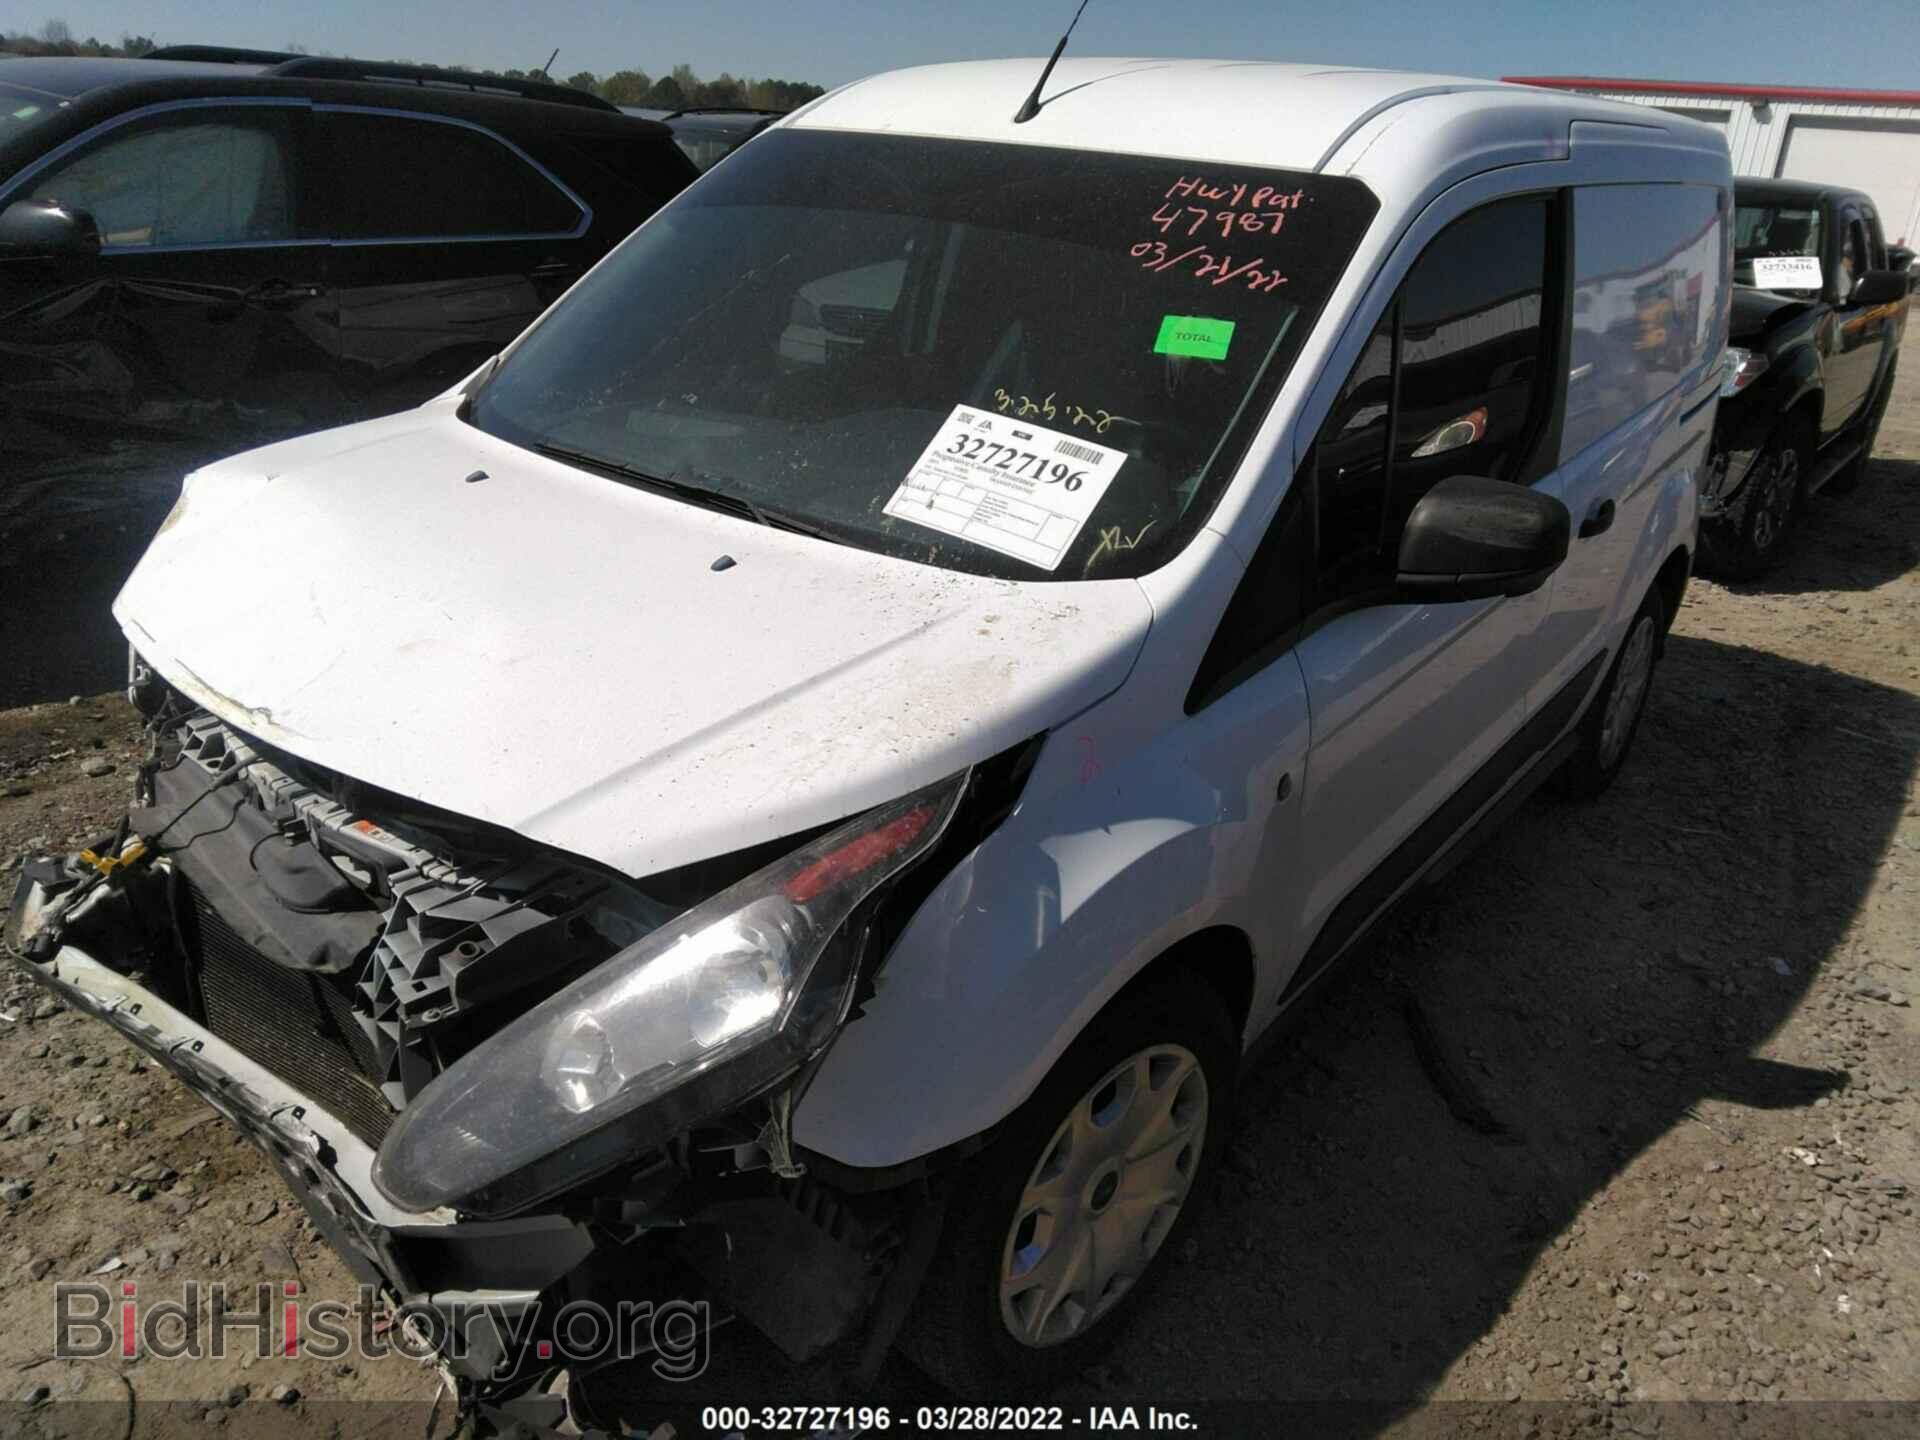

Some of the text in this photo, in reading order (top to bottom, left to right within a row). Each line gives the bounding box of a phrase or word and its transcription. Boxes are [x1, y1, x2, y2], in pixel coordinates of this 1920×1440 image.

[1152, 202, 1285, 237] 47987
[1130, 241, 1289, 292] 03/21/22
[1175, 331, 1213, 343] TOTAL
[946, 433, 1090, 492] 32727196
